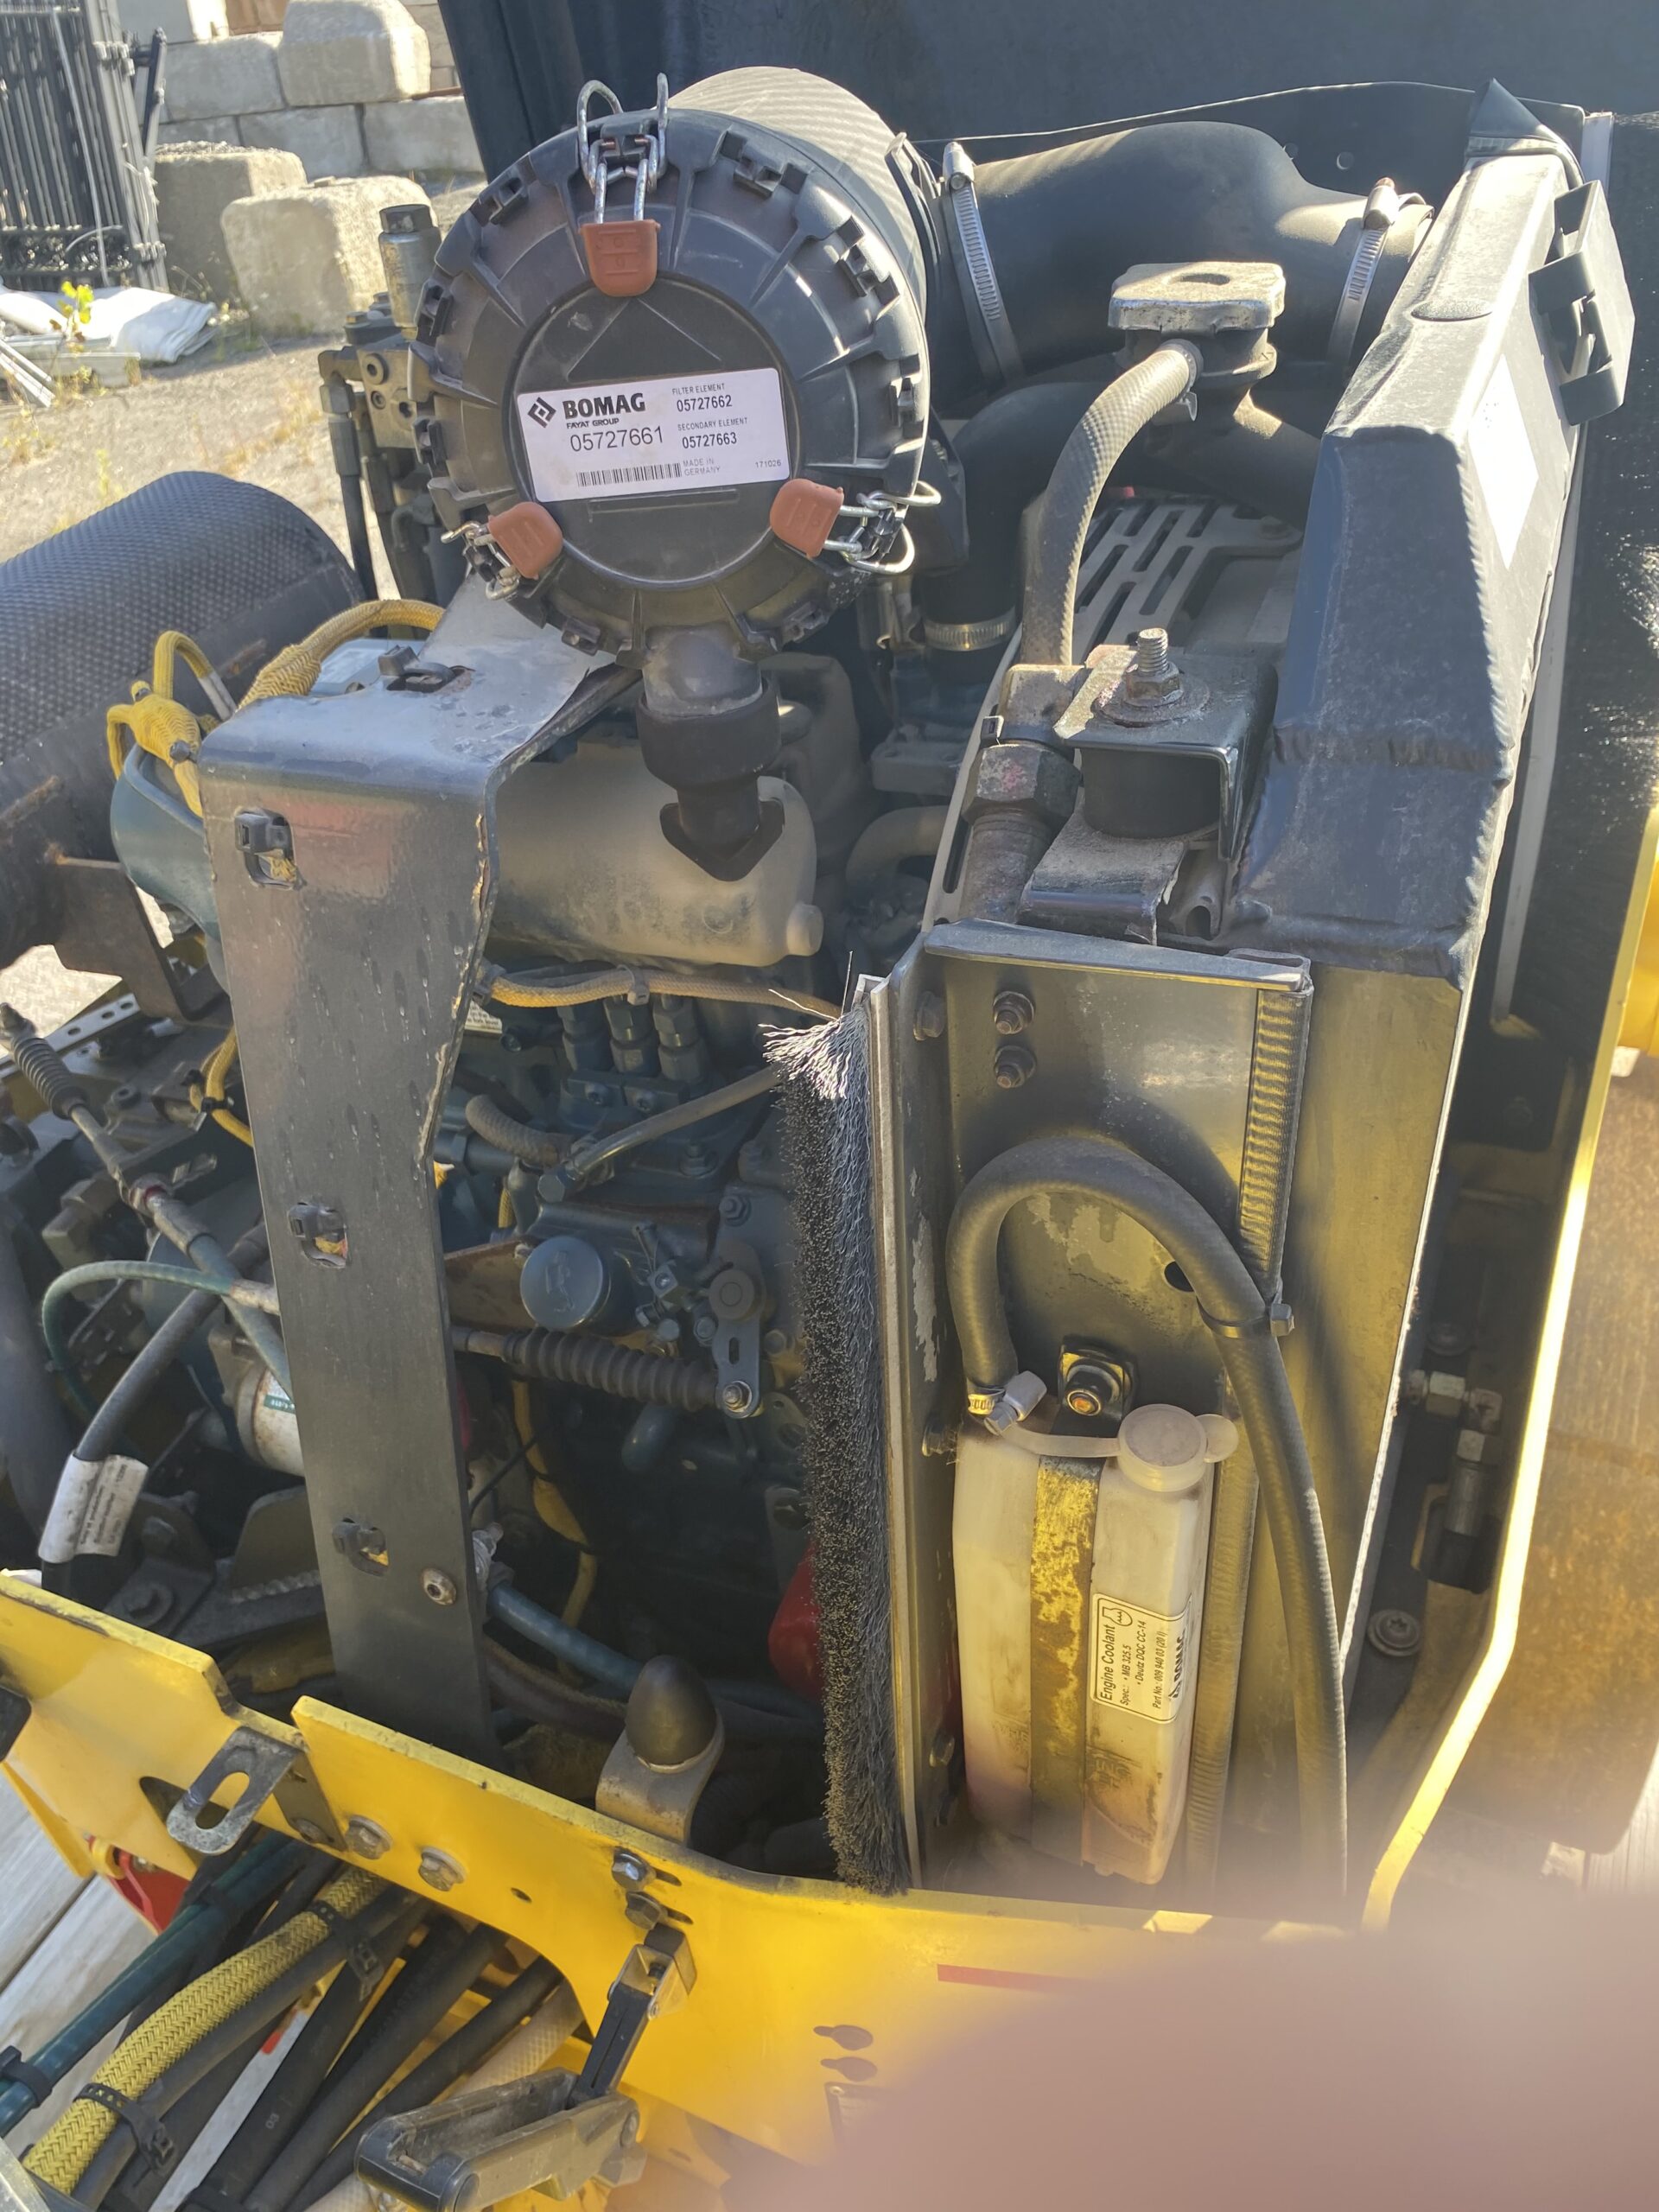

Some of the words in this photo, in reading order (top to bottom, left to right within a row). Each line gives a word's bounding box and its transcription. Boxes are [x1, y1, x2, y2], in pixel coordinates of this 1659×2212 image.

[671, 386, 694, 395] FILTER
[696, 383, 725, 393] ELEMENT
[563, 392, 645, 420] BOMAG
[677, 394, 733, 412] 05727662
[592, 417, 620, 427] GROUP
[677, 421, 716, 431] SECONDARY
[718, 417, 747, 427] ELEMENT
[570, 425, 663, 452] 05727661
[682, 432, 737, 449] 05727663
[683, 458, 704, 467] MADE
[755, 459, 782, 468] 171026
[683, 467, 721, 476] GERMANY
[1137, 1620, 1147, 1643] CC-14
[1101, 1624, 1116, 1664] Coolant
[1122, 1644, 1132, 1664] 325.5
[1136, 1643, 1146, 1661] DQC
[1154, 1656, 1165, 1669] 940
[1122, 1664, 1131, 1677] MB
[1135, 1661, 1145, 1681] Deutz
[1154, 1669, 1163, 1682] 009
[1100, 1666, 1116, 1700] Engine
[1152, 1695, 1161, 1709] Part
